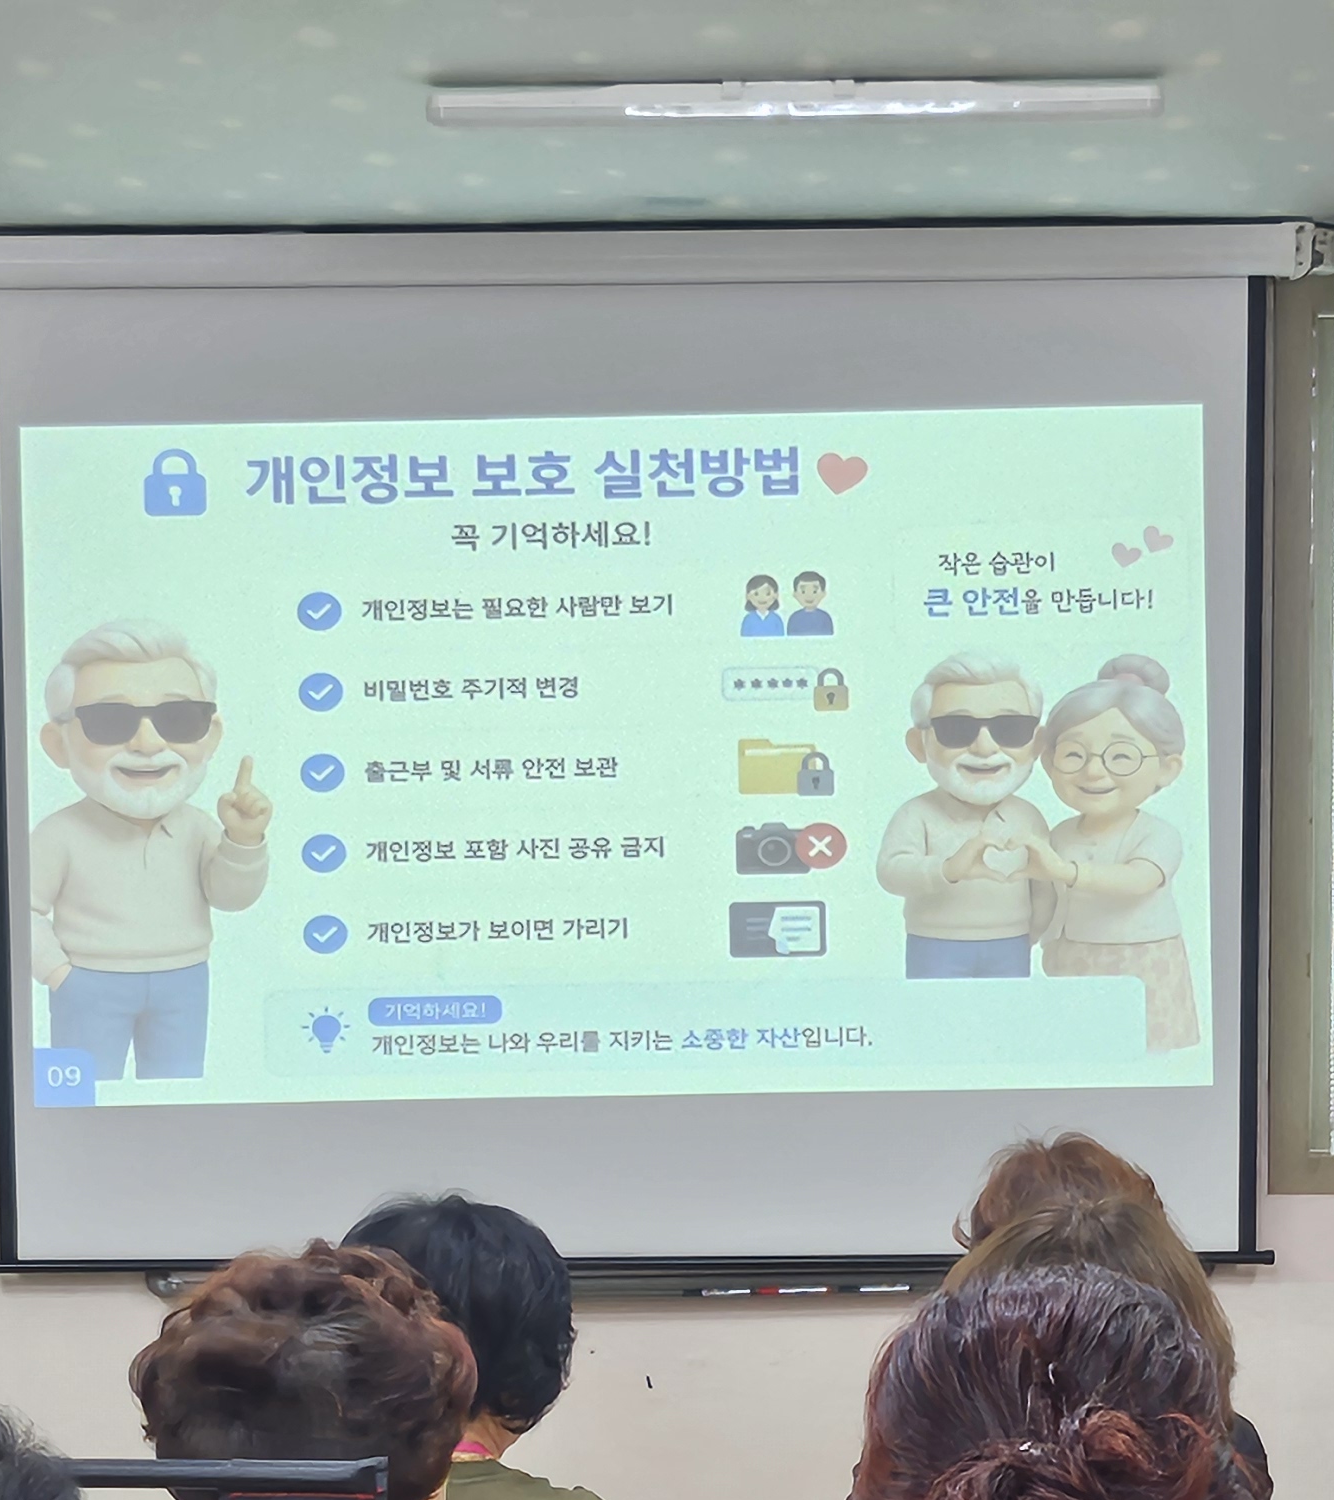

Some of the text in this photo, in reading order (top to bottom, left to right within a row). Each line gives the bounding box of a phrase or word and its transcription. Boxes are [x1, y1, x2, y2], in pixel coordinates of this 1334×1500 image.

[246, 445, 800, 505] 개인정보 보호 실천방법
[451, 521, 651, 551] 꼭 기억하세요!
[938, 551, 1055, 575] 작은 습관이
[362, 594, 673, 622] 개인정보는 필요한 사람만 보기
[923, 586, 1154, 617] 큰 안전을 만듭니다!
[363, 676, 579, 702] 비밀번호 주기적 변경
[440, 759, 461, 782] 및
[469, 758, 514, 781] 서류
[521, 757, 566, 780] 안전
[573, 756, 618, 779] 보관
[366, 835, 665, 864] 개인정보 포함 사진 공유 금지
[367, 917, 629, 944] 개인정보가 보이면 가리기
[385, 1001, 486, 1021] 기억하세요!
[371, 1033, 480, 1056] 개인정보는
[488, 1032, 530, 1054] 나와
[609, 1029, 673, 1053] 지키는
[681, 1028, 749, 1052] 소중한
[756, 1026, 873, 1050] 자산입니다.
[47, 1066, 81, 1087] 09
